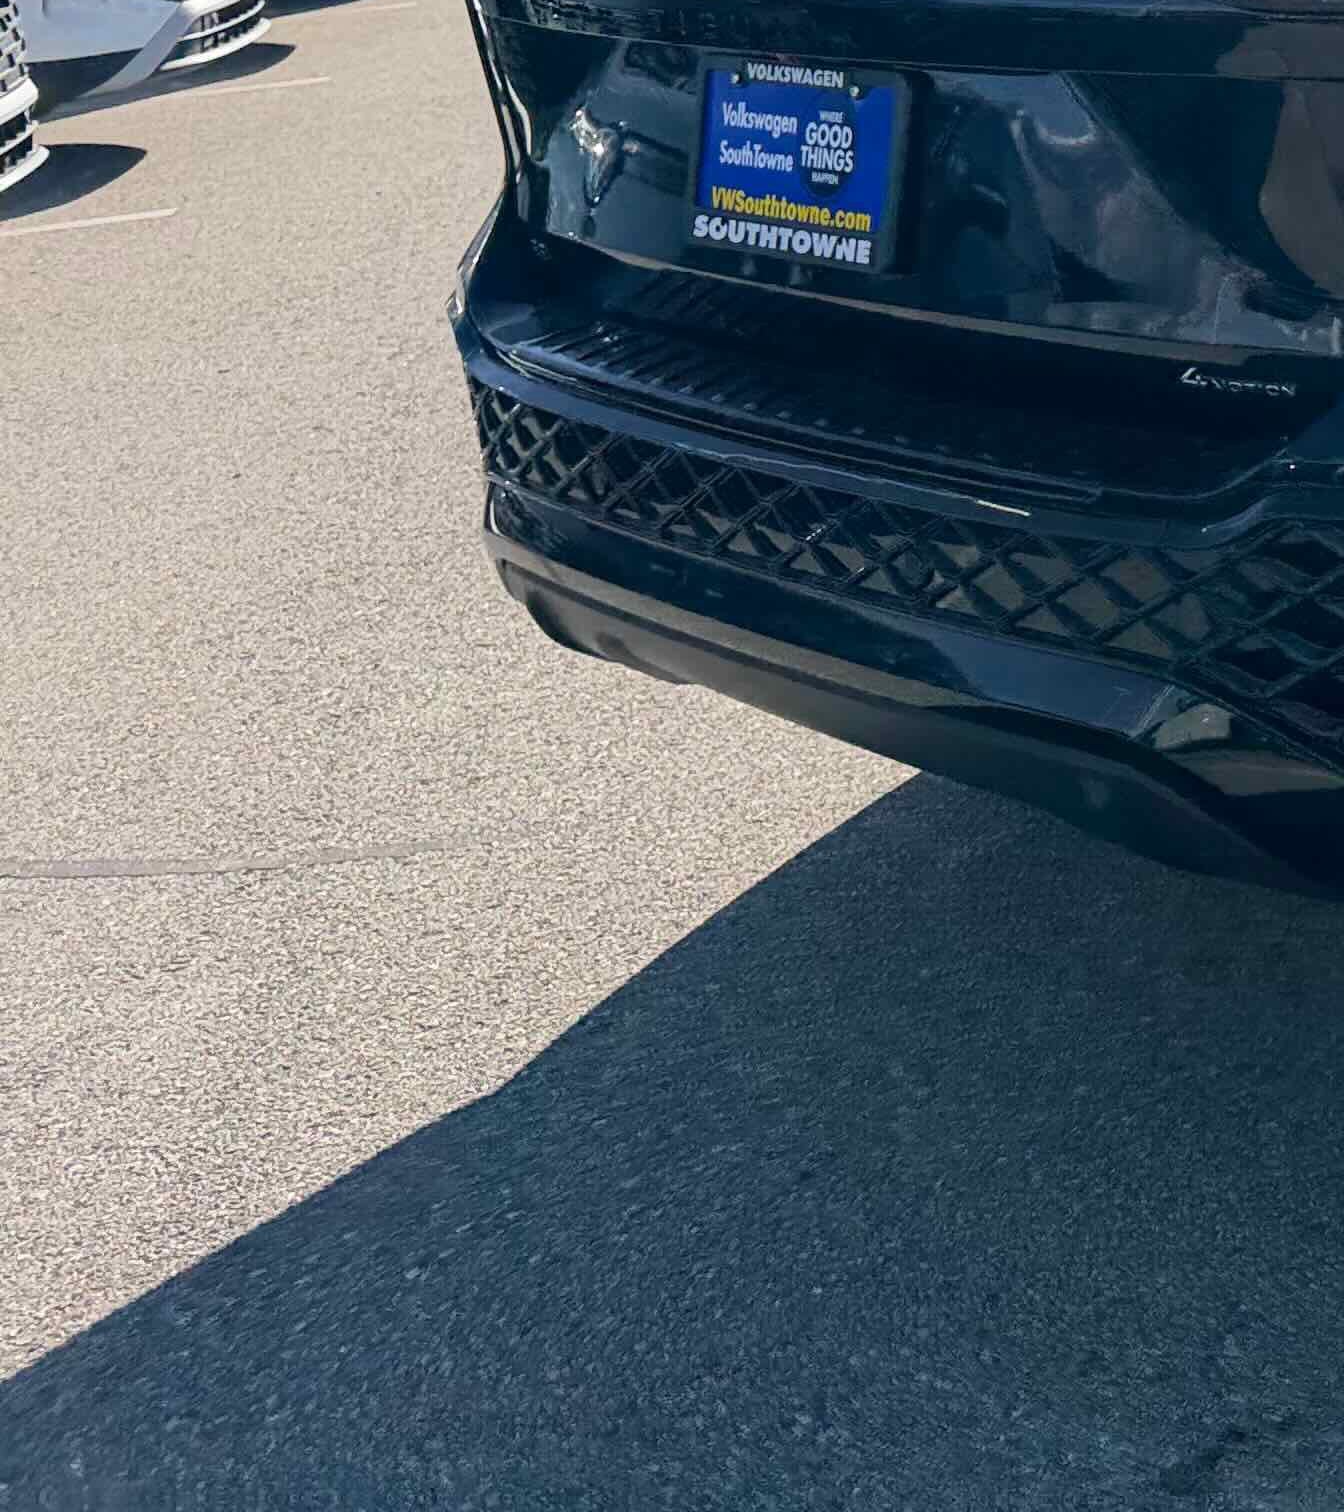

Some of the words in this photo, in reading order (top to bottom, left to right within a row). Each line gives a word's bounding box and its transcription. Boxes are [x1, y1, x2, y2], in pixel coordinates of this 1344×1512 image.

[747, 63, 844, 88] VOLKSWAGEN
[722, 101, 798, 139] Volkswagen
[805, 122, 853, 149] GOOD
[719, 140, 793, 173] SouthTowne
[800, 145, 854, 173] THINGS
[711, 185, 871, 232] VWSouthtowne.com
[693, 215, 872, 265] SOUTHTOWNE
